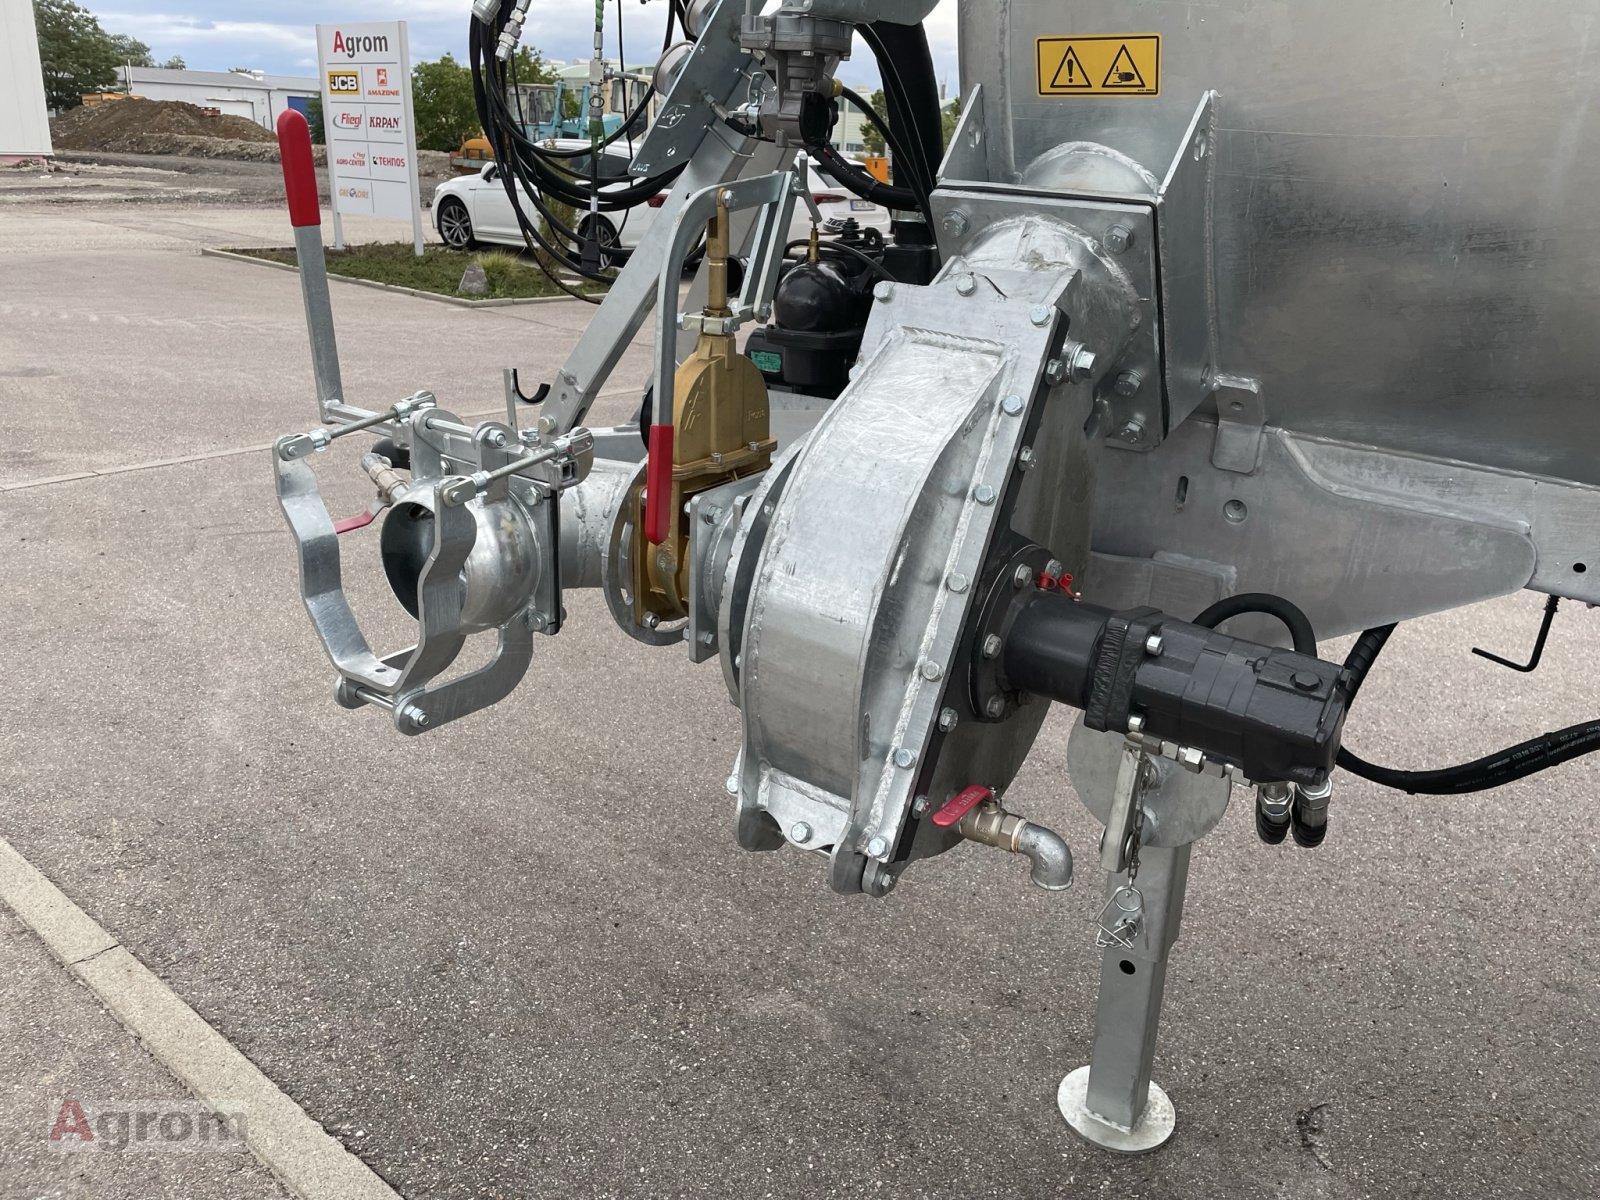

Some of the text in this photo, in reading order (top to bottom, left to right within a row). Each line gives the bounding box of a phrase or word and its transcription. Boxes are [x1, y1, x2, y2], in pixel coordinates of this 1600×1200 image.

[333, 30, 389, 59] Agrom
[331, 75, 357, 91] JCB
[341, 112, 362, 128] Fliegl
[369, 116, 400, 129] KRPAN
